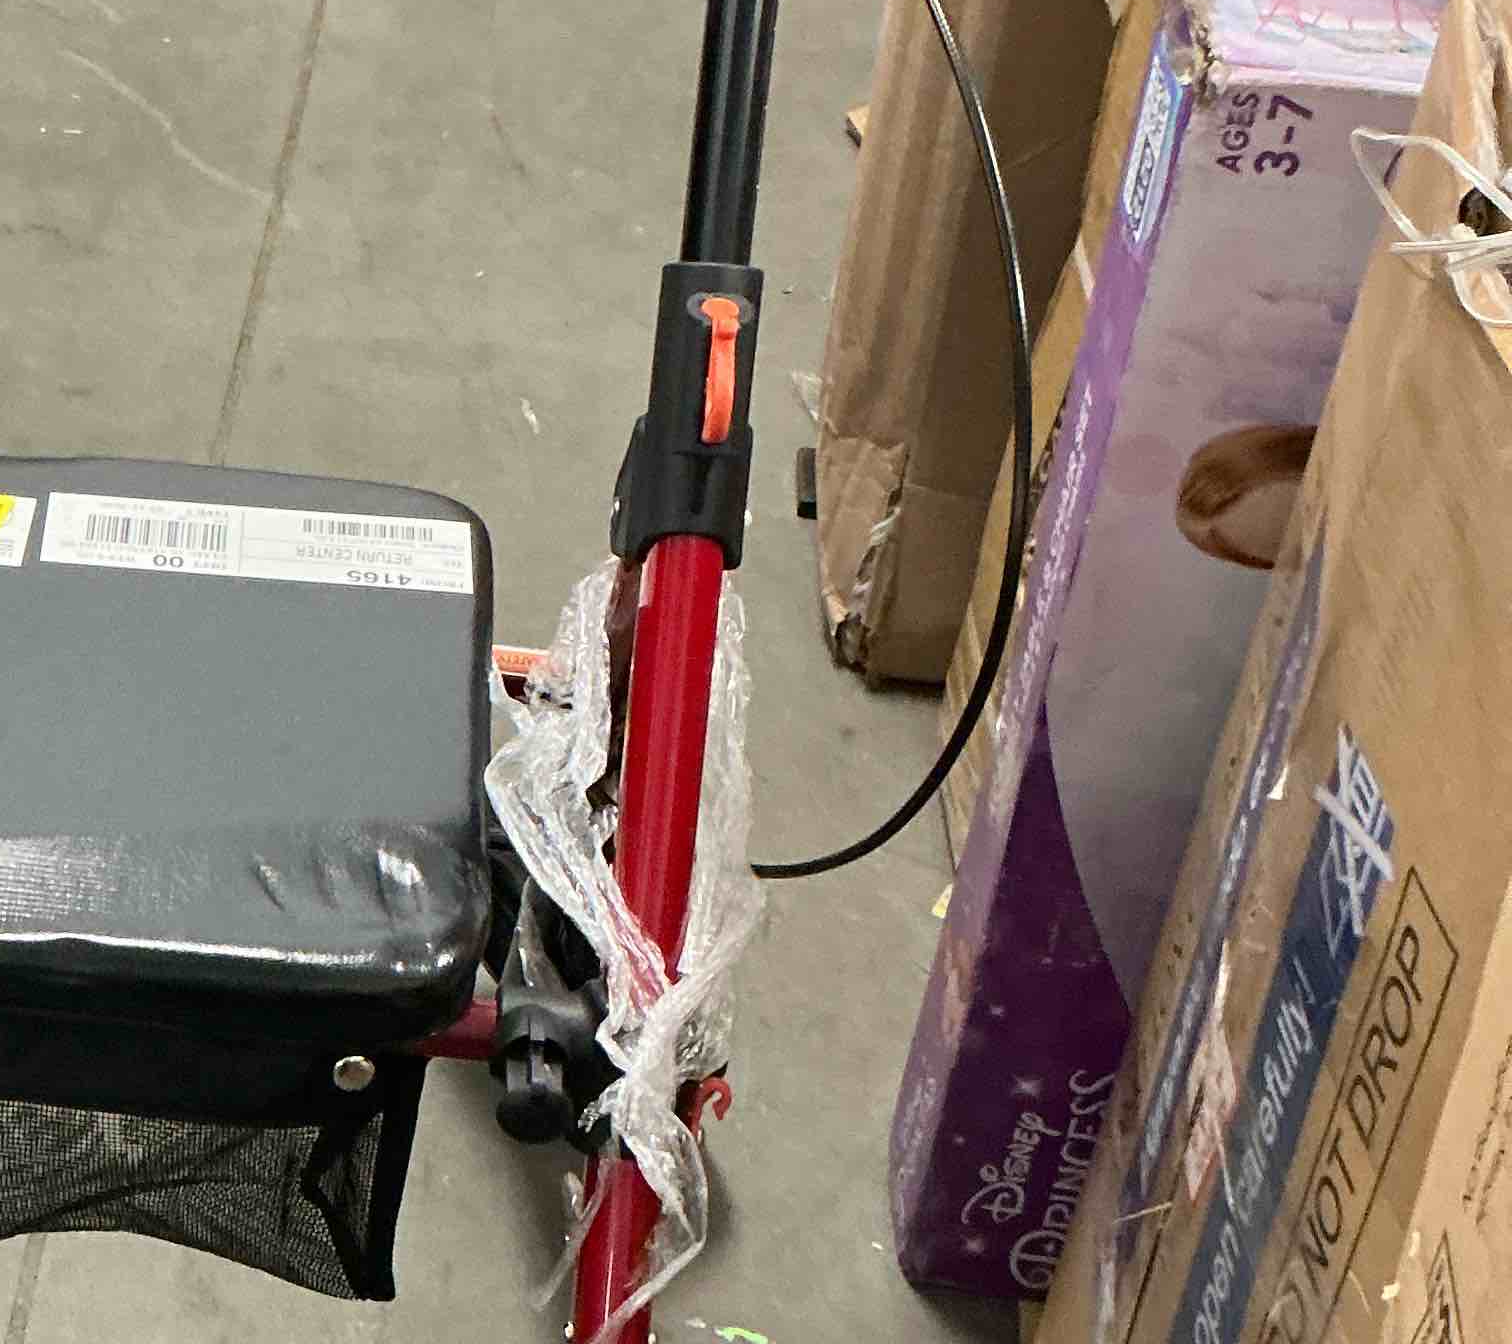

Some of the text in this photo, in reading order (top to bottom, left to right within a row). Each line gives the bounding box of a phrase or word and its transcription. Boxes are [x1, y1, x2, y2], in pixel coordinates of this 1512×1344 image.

[1216, 93, 1259, 173] AGES
[1254, 95, 1313, 176] 3-7
[296, 544, 413, 566] RETURN CENTER
[346, 568, 413, 587] 4165
[1299, 1128, 1356, 1300] NOT
[1345, 924, 1423, 1151] DROP
